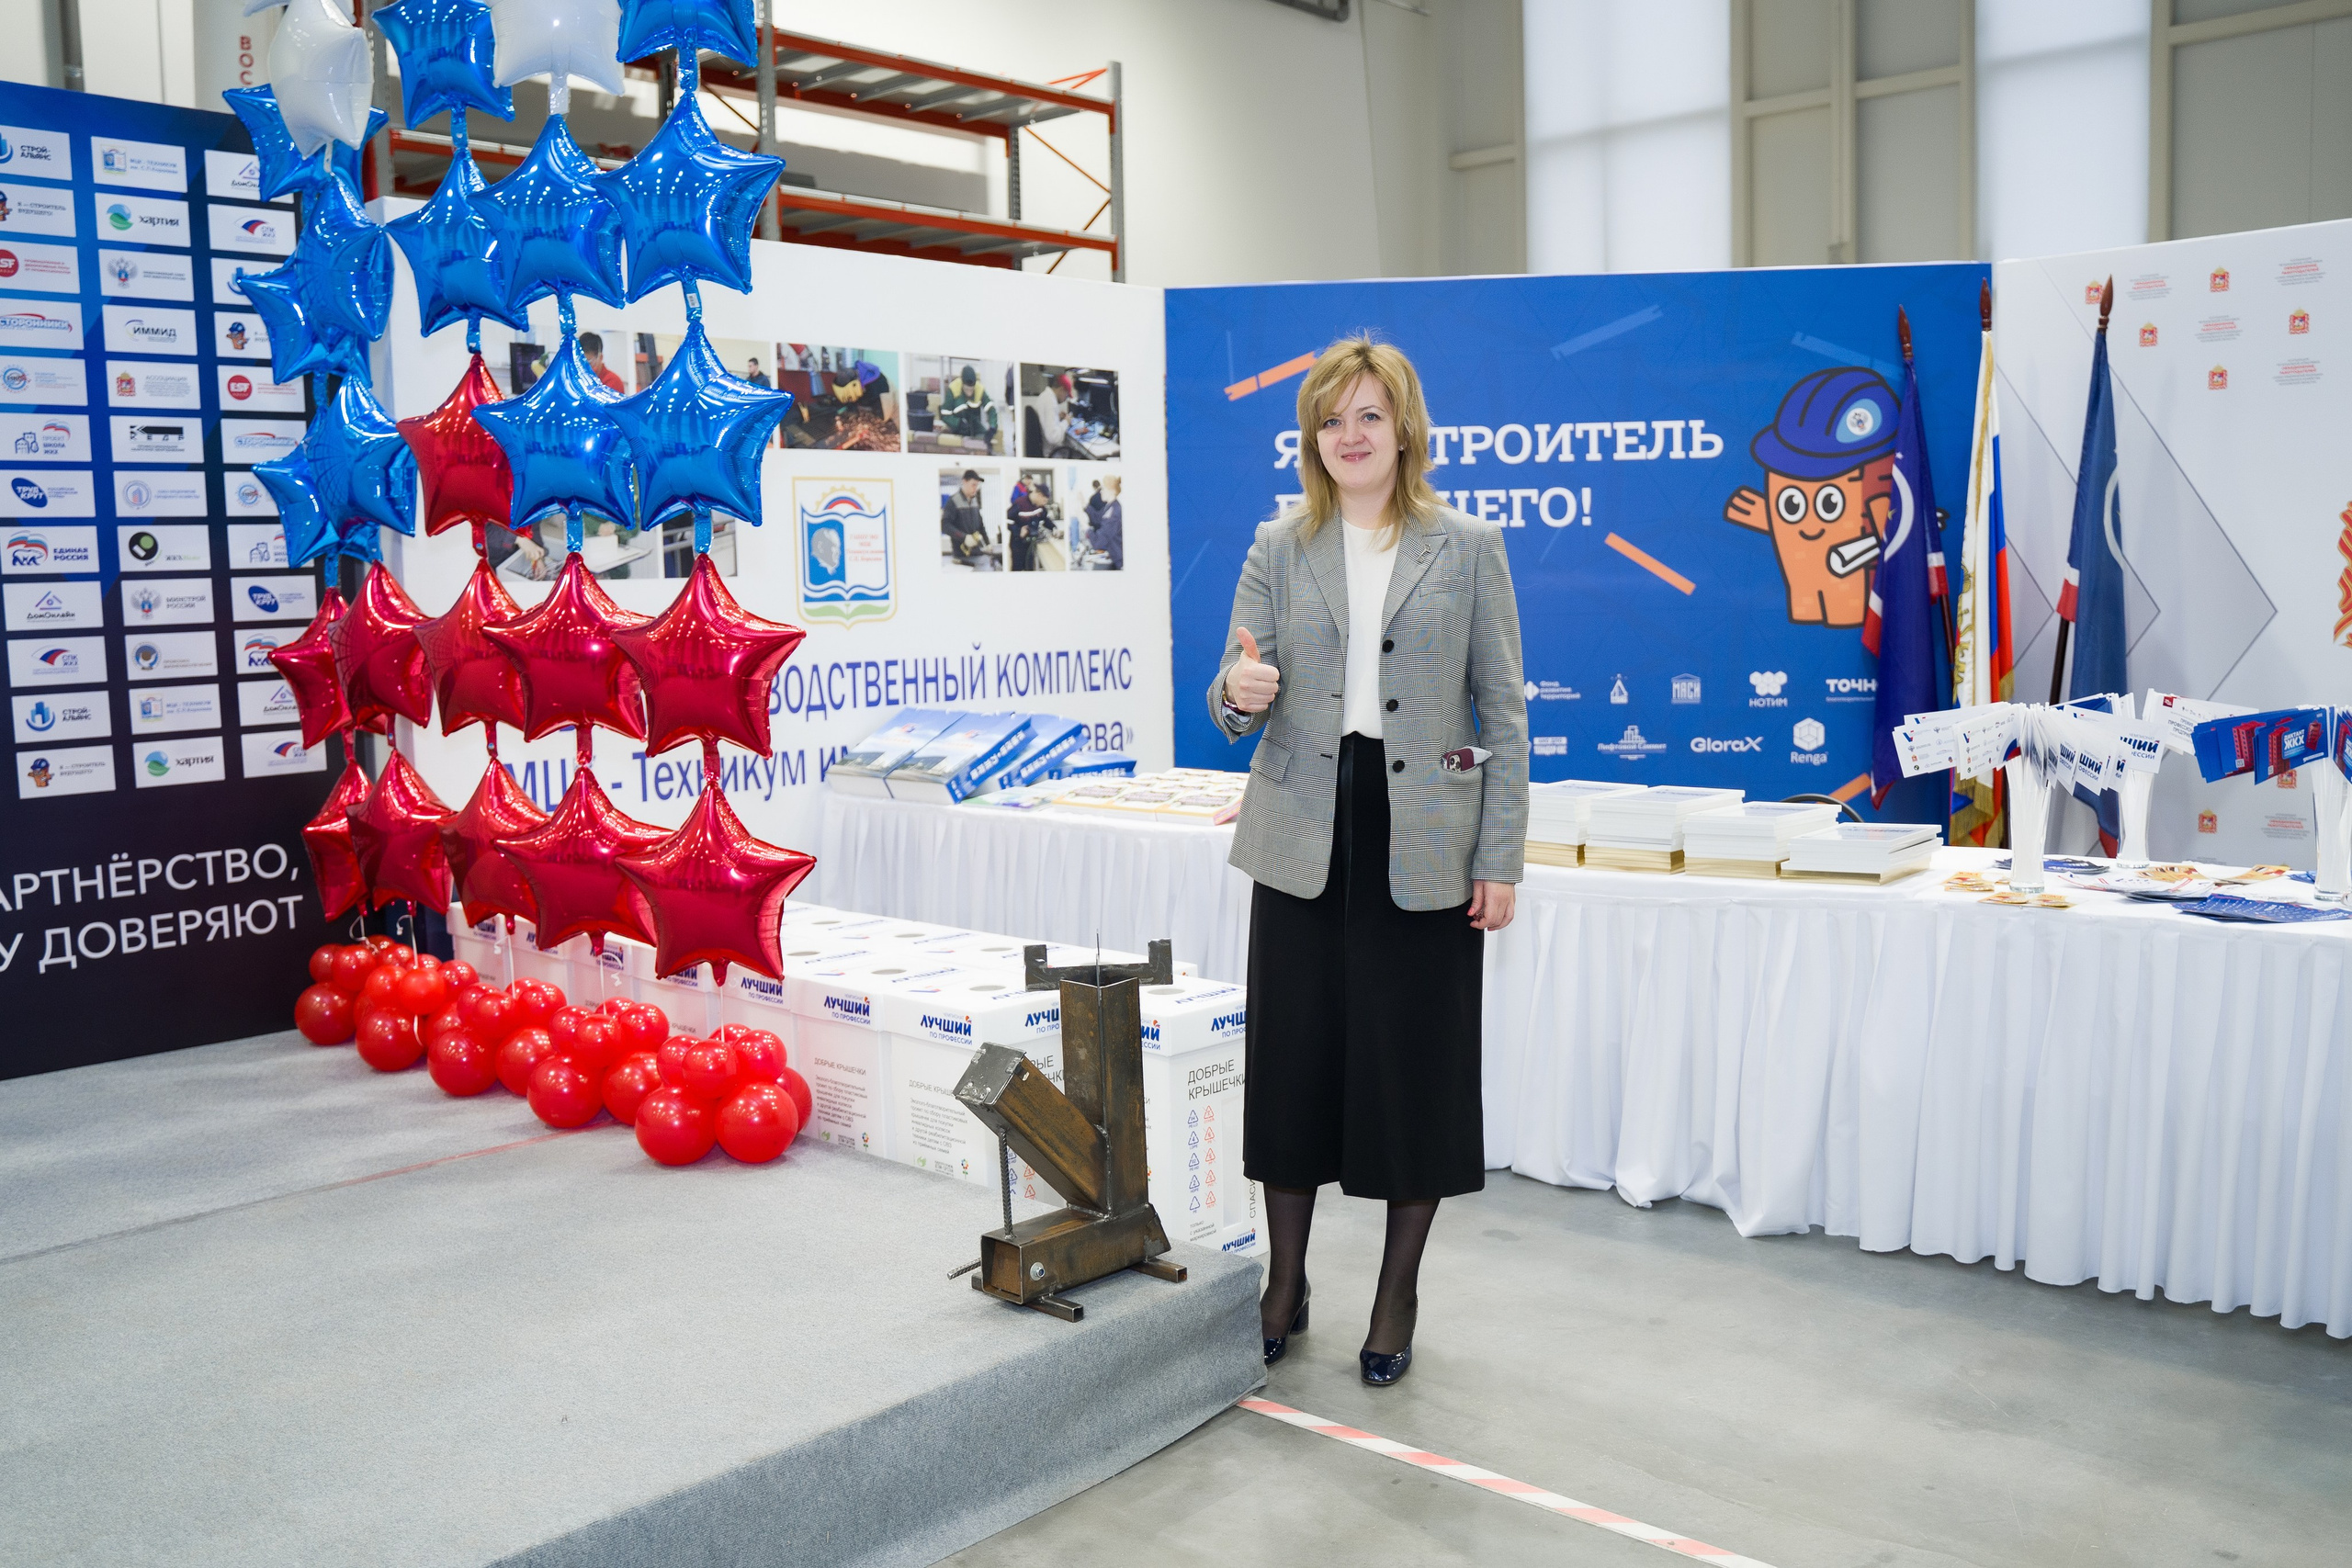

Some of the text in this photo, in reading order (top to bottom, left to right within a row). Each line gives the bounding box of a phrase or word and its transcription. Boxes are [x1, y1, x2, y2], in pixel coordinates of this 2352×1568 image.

[139, 215, 179, 228] хартия
[1428, 419, 1724, 465] ТРОИТЕЛЬ
[997, 648, 1133, 699] КОМПЛЕКС
[1749, 697, 1788, 707] НОТИМ
[1690, 737, 1764, 752] GloraX
[1791, 751, 1826, 766] Renga
[39, 895, 303, 974] ДОВЕРЯЮТ
[823, 995, 870, 1017] ЛУЧШИЙ
[831, 1011, 871, 1025] ПО ПРОФЕССИИ
[921, 1014, 971, 1037] ЛУЧШИЙ
[929, 1031, 972, 1046] ПО ПРОФЕССИИ
[1222, 1030, 1231, 1038] ПО
[1188, 1059, 1235, 1086] ДОБРЫЕ
[1221, 1228, 1256, 1251] ЛУЧШИЙ
